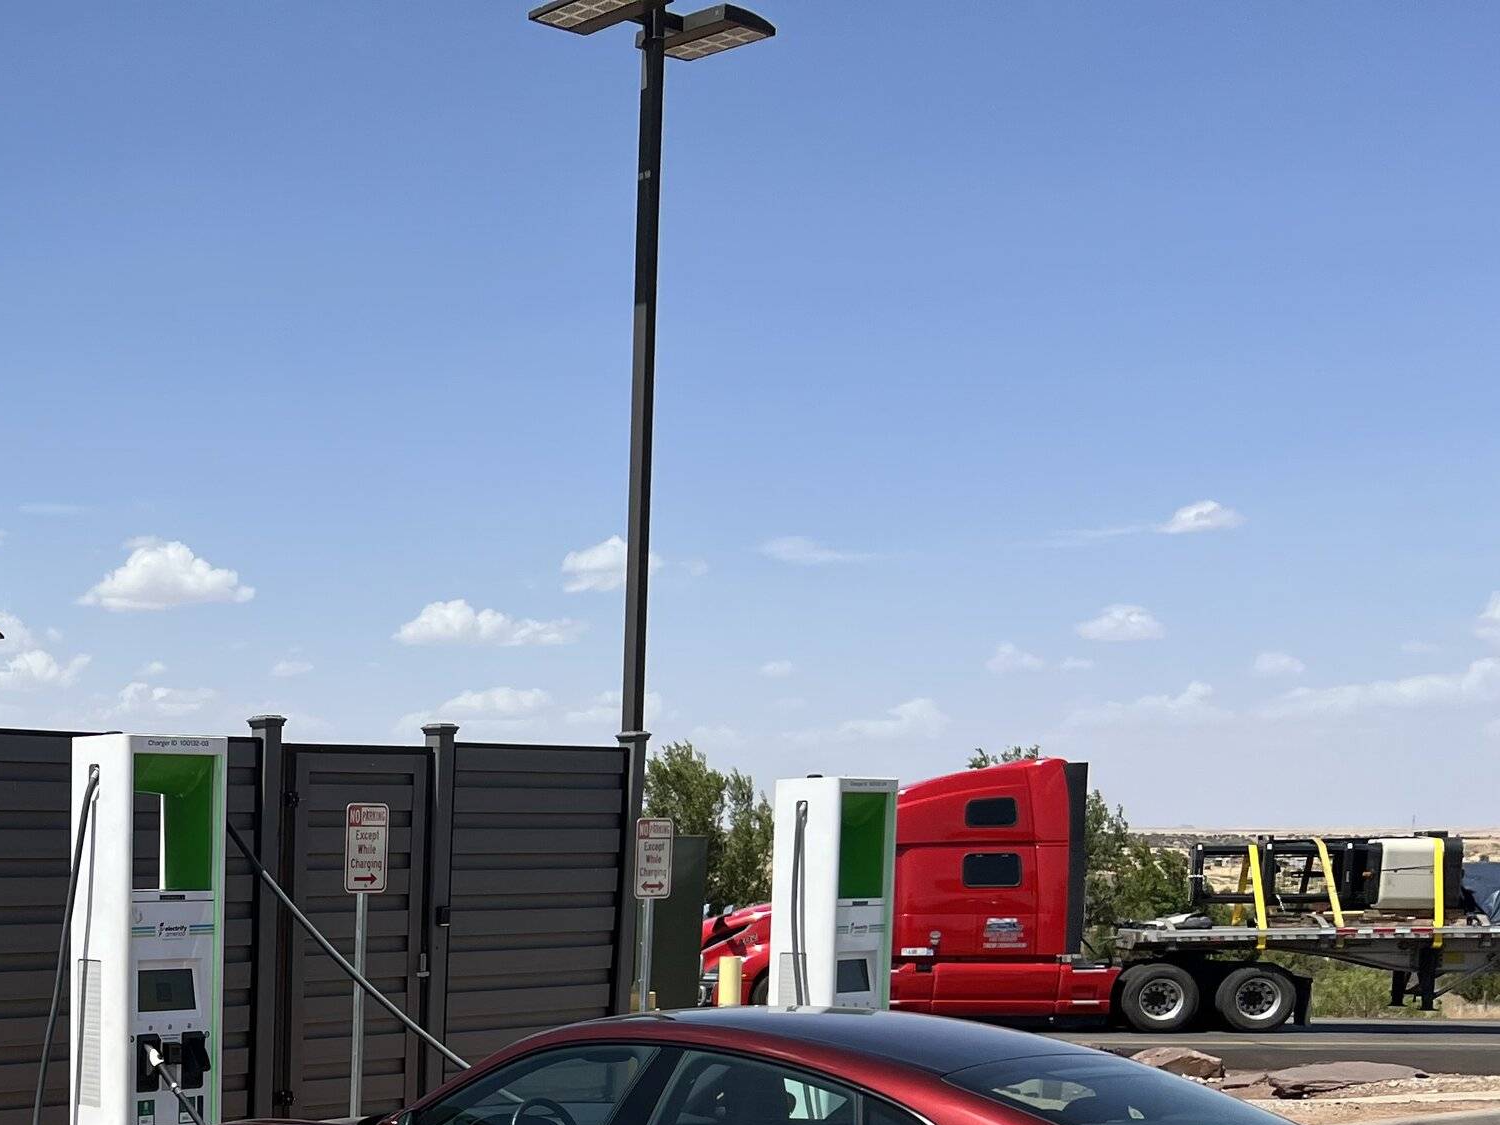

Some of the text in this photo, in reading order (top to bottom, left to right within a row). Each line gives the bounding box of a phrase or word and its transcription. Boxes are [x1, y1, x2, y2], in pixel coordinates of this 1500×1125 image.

[349, 809, 360, 824] NO
[356, 830, 380, 842] Except
[357, 844, 377, 854] While
[644, 842, 665, 852] Except
[350, 858, 382, 871] Charging
